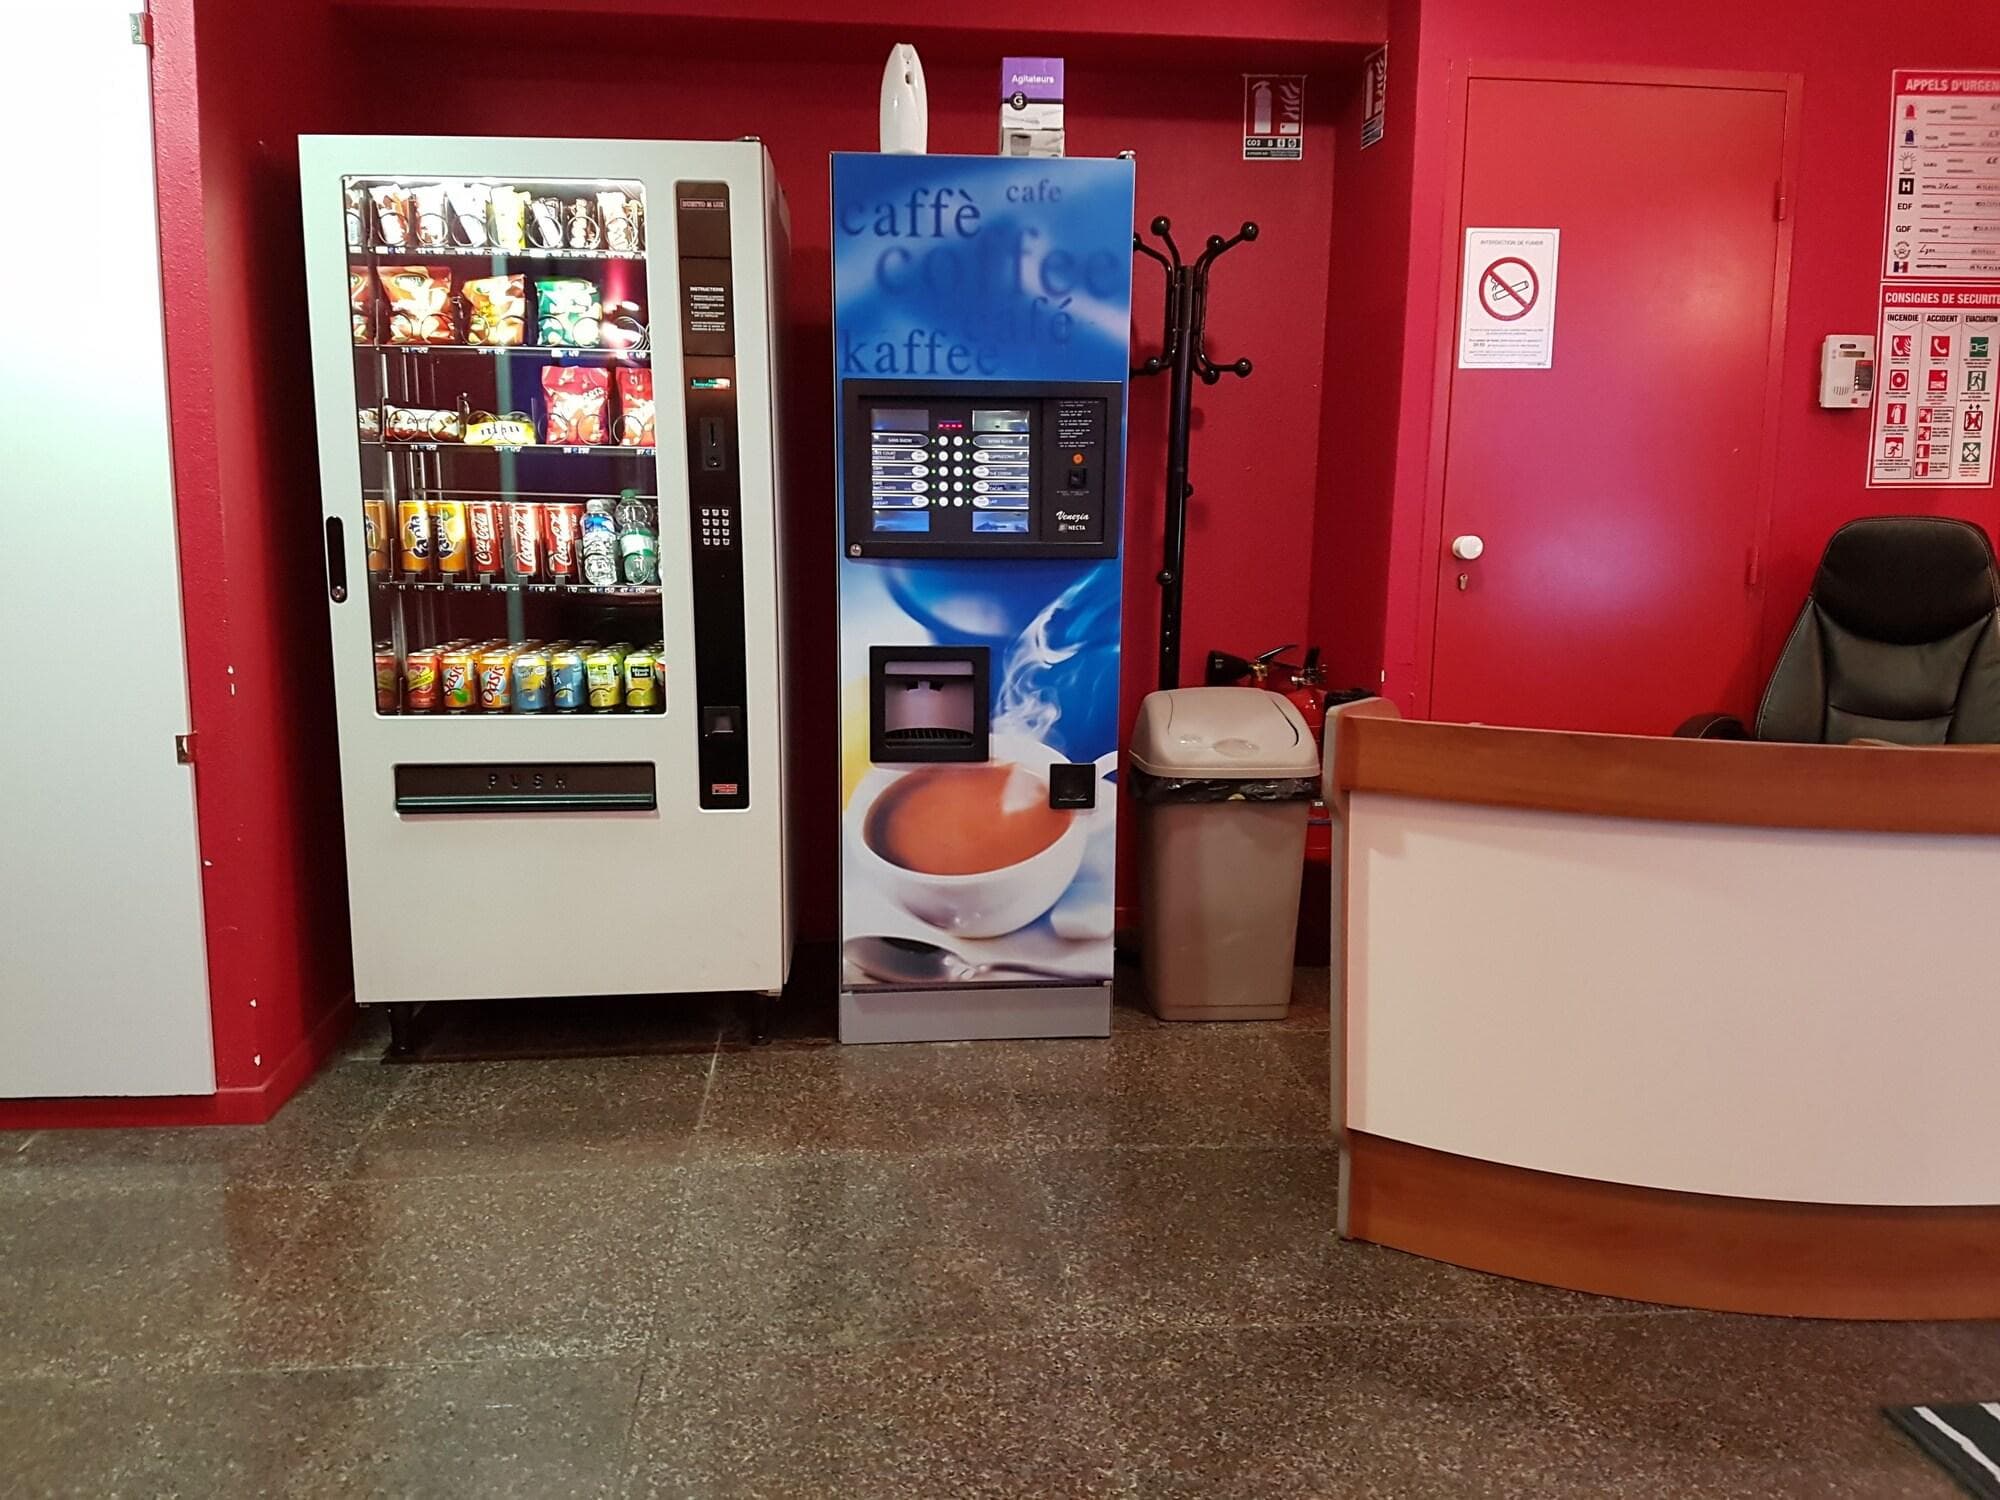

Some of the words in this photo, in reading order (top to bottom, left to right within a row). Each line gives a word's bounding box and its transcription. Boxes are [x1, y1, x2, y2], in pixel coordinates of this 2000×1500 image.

[1011, 75, 1054, 85] Agitateurs
[1904, 79, 1949, 92] APPELS
[1005, 178, 1063, 203] cafe
[838, 187, 982, 238] caffè
[1885, 292, 1940, 304] CONSIGNES
[1942, 293, 1955, 304] DE
[1957, 293, 2000, 305] SECURITE
[1887, 314, 1919, 322] INCENDIE
[1926, 314, 1958, 323] ACCIDENT
[1965, 315, 1998, 323] EVACUATION
[842, 327, 1000, 376] kaffee
[1056, 510, 1090, 523] Venezia
[481, 665, 506, 704] Oasis
